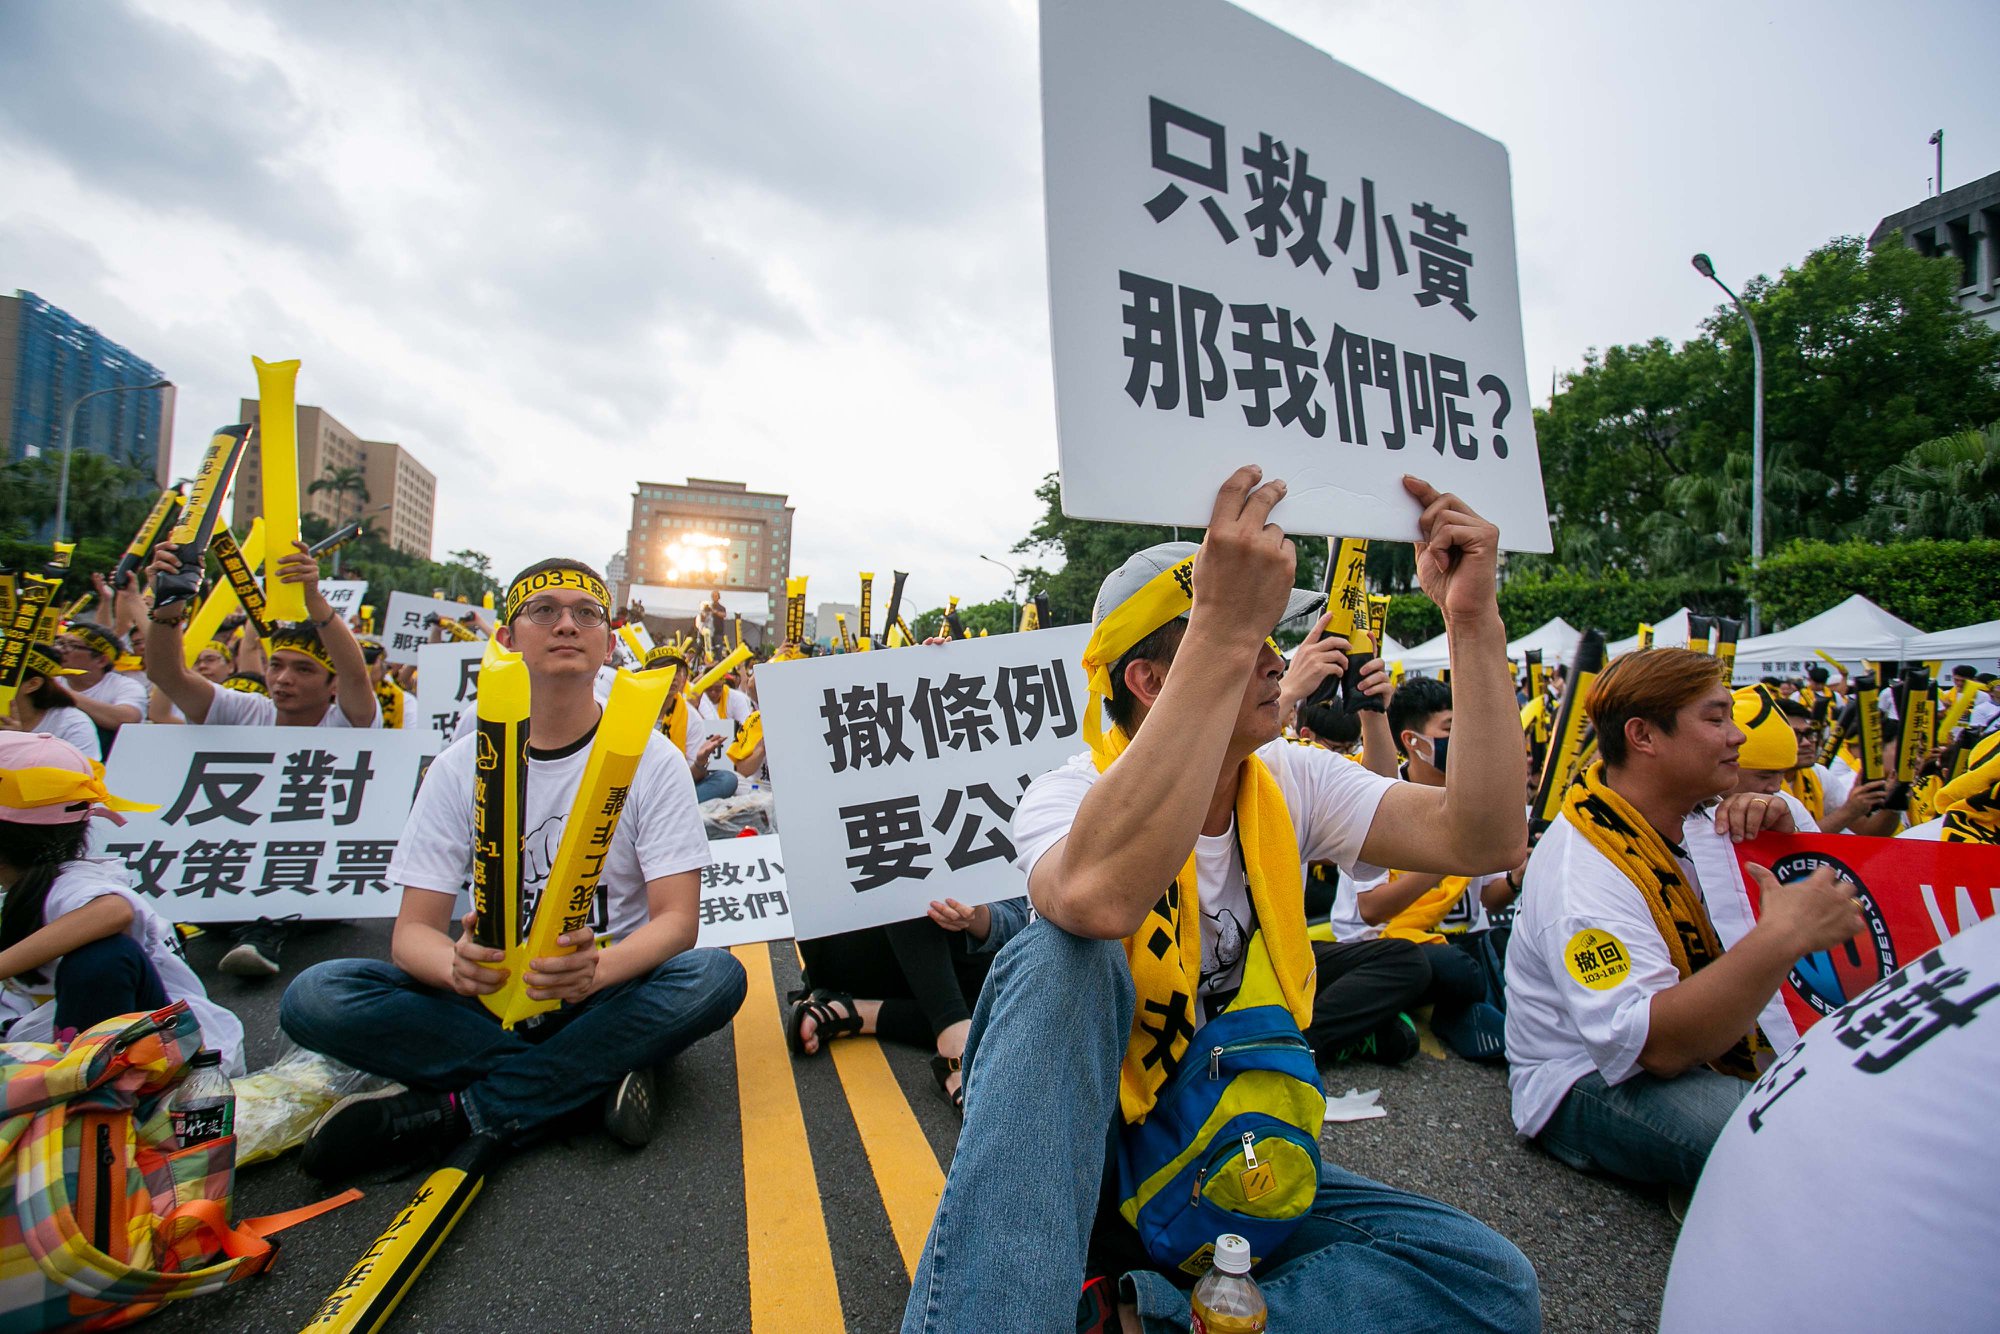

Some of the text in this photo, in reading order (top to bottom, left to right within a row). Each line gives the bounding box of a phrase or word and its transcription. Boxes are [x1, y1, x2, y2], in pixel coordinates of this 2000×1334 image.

[1143, 95, 1478, 322] 只救小黃
[1118, 269, 1512, 461] 那我們呢?
[819, 658, 1079, 774] 撤條例
[161, 750, 375, 826] 反對
[839, 772, 1034, 893] 要公
[105, 839, 403, 899] 政策買票
[1574, 941, 1624, 973] 撤回
[1583, 963, 1628, 984] 103-1惡法!
